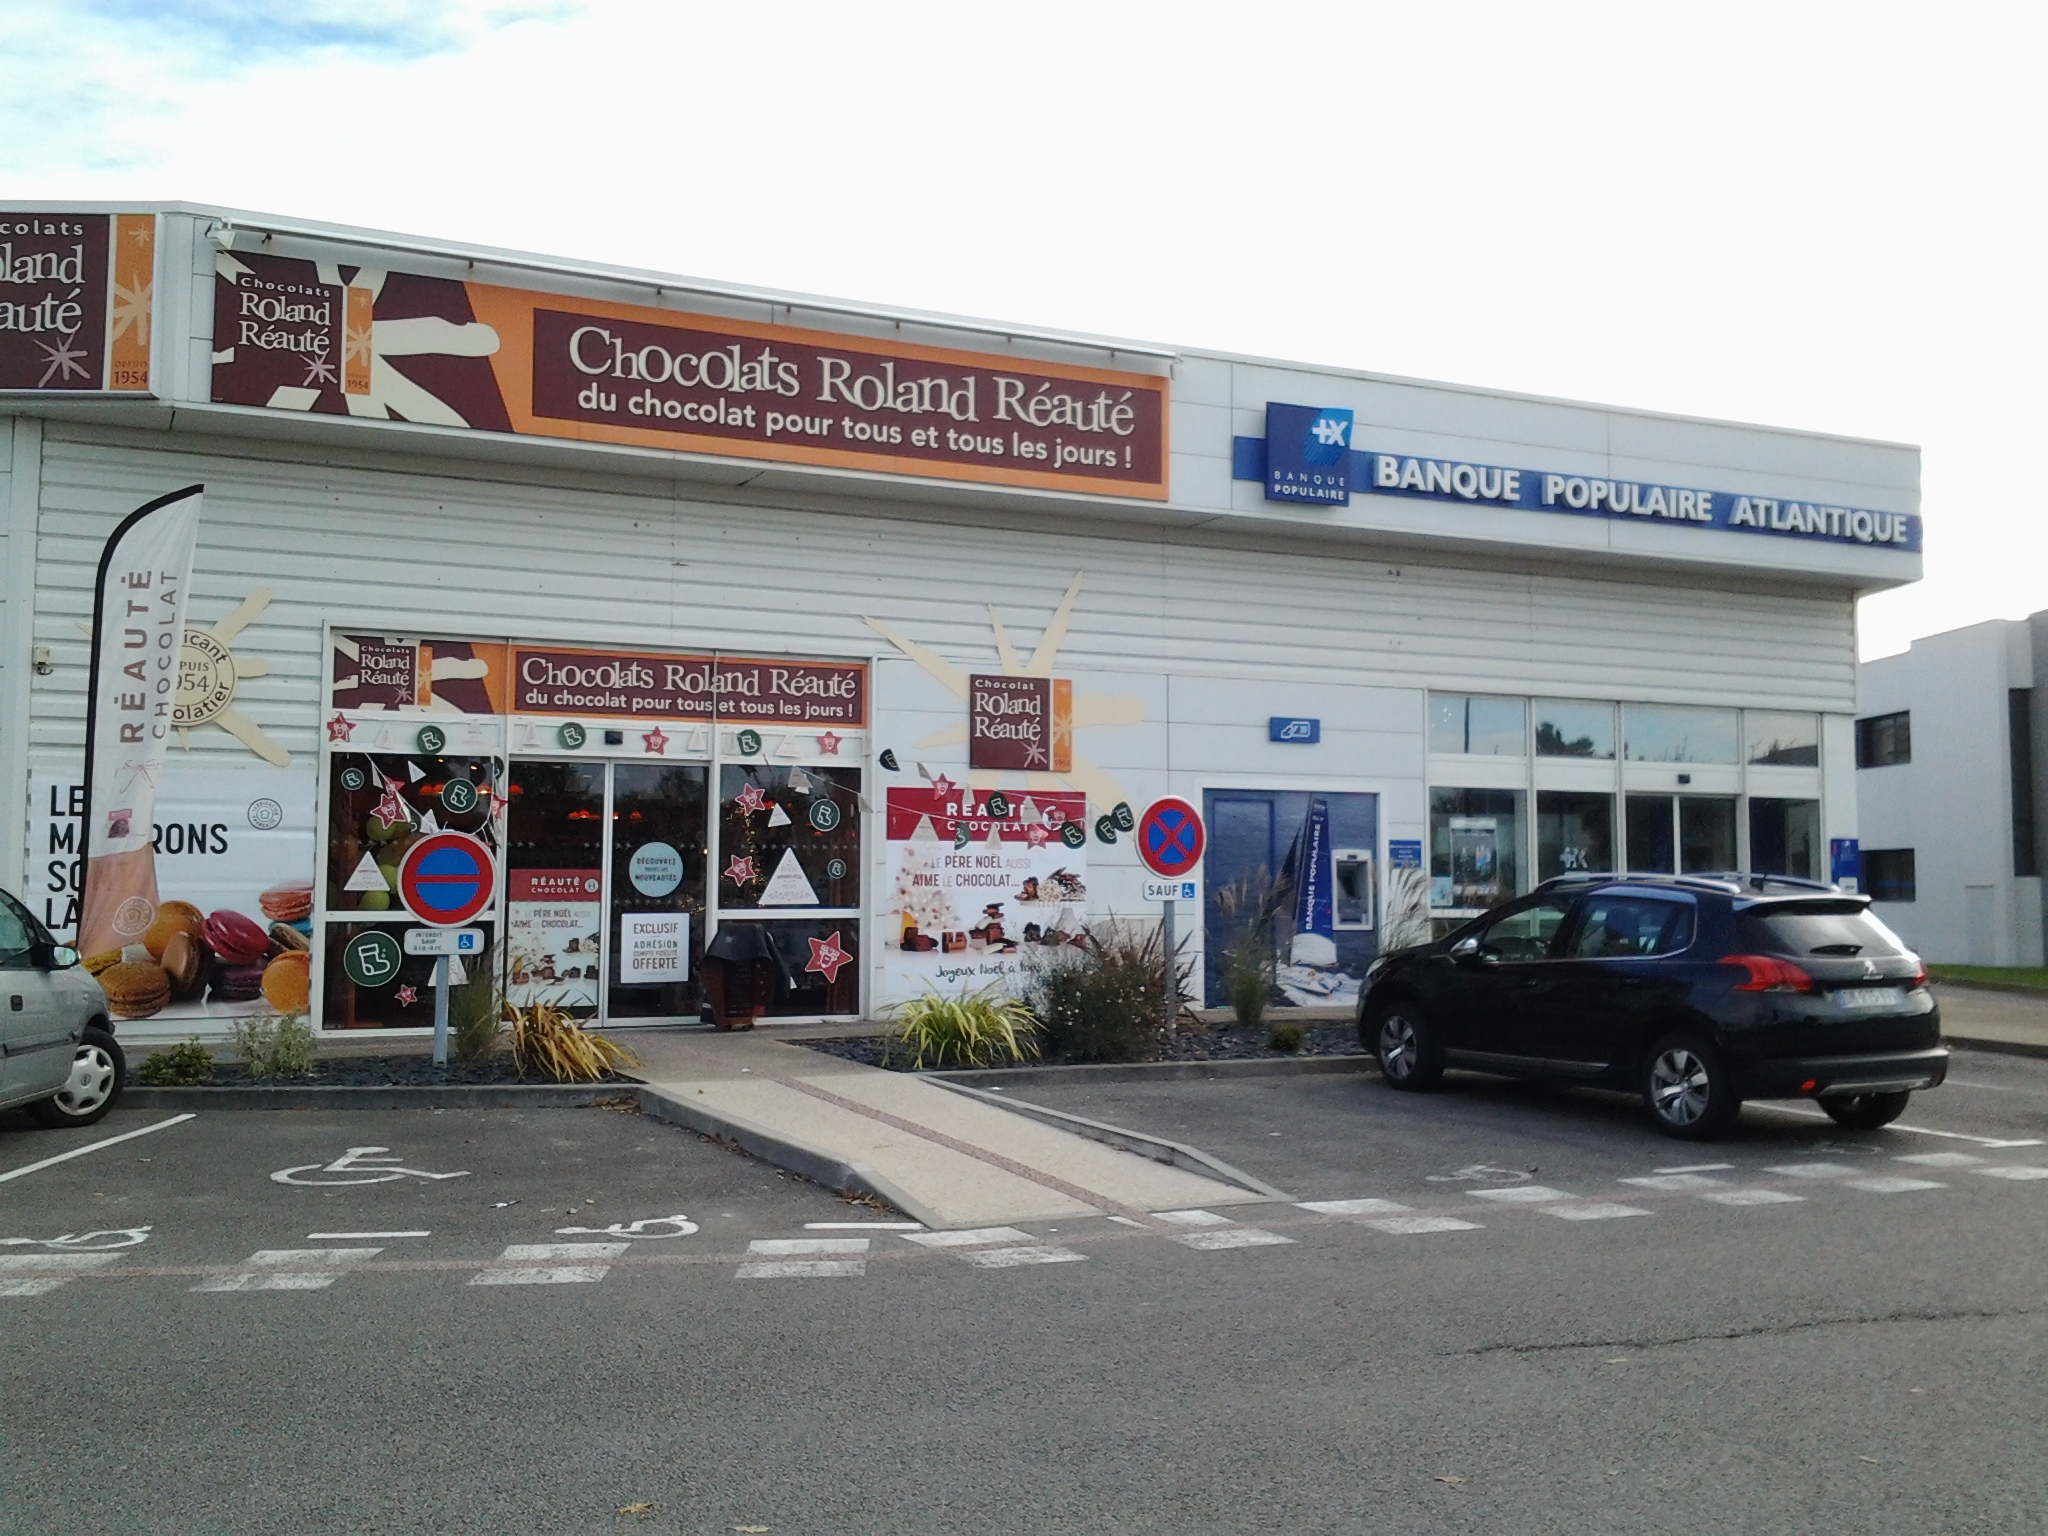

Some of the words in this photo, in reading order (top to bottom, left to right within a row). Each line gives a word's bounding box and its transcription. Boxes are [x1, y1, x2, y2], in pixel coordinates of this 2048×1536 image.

[0, 242, 86, 284] land
[241, 277, 331, 297] Chocolats
[239, 292, 331, 326] Roland
[238, 320, 330, 355] Réauté
[114, 371, 149, 385] 1954
[347, 379, 369, 390] 1954
[570, 326, 800, 397] Chocolats
[816, 356, 980, 424] Roland
[992, 376, 1135, 436] Réauté
[578, 382, 617, 411] du
[628, 388, 757, 429] chocolat
[766, 411, 833, 437] pour
[841, 417, 902, 445] tous
[911, 426, 940, 449] et
[947, 428, 1004, 456] tous
[1012, 431, 1048, 460] les
[1053, 437, 1118, 469] jours
[1125, 445, 1132, 469] !
[1274, 470, 1345, 487] BANQUE
[1273, 484, 1345, 501] POPULAIRE
[1374, 455, 1521, 501] BANQUE
[1542, 474, 1713, 522] POPULAIRE
[1728, 496, 1908, 544] ATLANTIQUE
[152, 571, 178, 740] CHOCOLAT
[361, 645, 410, 654] Chocolats
[360, 653, 411, 669] Roland
[360, 669, 410, 686] Réauté
[522, 657, 654, 689] Chocolats
[664, 664, 761, 697] Roland
[769, 668, 856, 699] Réauté
[975, 679, 1035, 691] Chocolat
[525, 689, 548, 705] du
[553, 689, 628, 709] chocolat
[632, 696, 673, 712] pour
[677, 697, 713, 712] tous
[719, 699, 736, 713] et
[740, 700, 775, 715] tous
[779, 700, 801, 716] les
[805, 704, 844, 719] jours
[848, 704, 853, 718] !
[974, 692, 1042, 716] Roland
[974, 716, 1041, 741] Réauté
[946, 820, 1029, 832] COCOLAT
[49, 823, 229, 855] MRONS
[944, 852, 972, 869] PÈRE
[976, 854, 1003, 869] NOËL
[1309, 823, 1321, 883] POPULAIRE
[531, 876, 580, 886] RÉAUTÉ
[912, 873, 940, 887] AIME
[1148, 884, 1179, 897] SAUF
[533, 907, 552, 918] PÈRE
[553, 907, 572, 918] NOËL
[1305, 885, 1316, 930] BANQUE
[633, 923, 678, 935] EXCLUSIF
[633, 938, 678, 949] ADHÉSION
[632, 957, 678, 970] OFFERTE
[935, 964, 976, 983] Joyeux
[979, 961, 1005, 976] Noël
